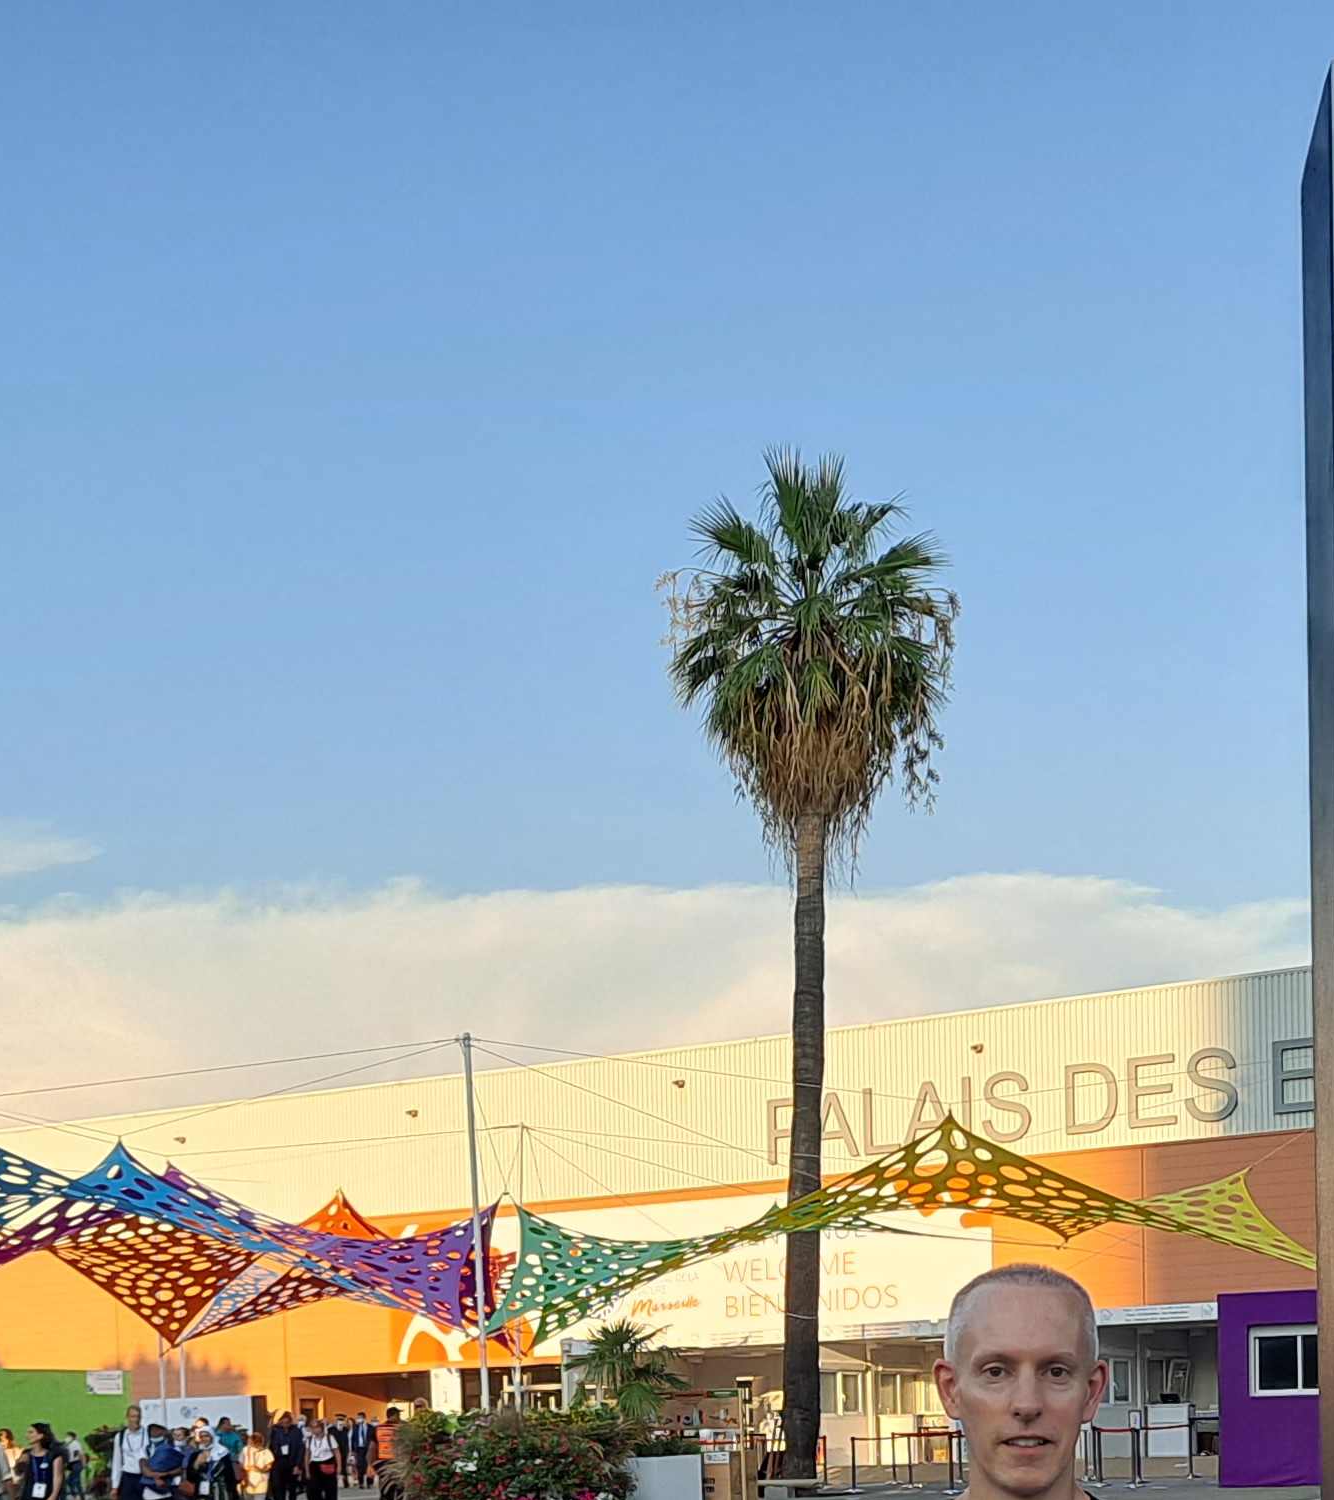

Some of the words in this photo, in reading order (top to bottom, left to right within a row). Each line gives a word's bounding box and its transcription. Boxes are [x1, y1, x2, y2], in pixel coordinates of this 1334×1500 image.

[1063, 1046, 1239, 1136] DES
[723, 1251, 856, 1283] WELCME
[725, 1284, 899, 1319] BIENNIDOS
